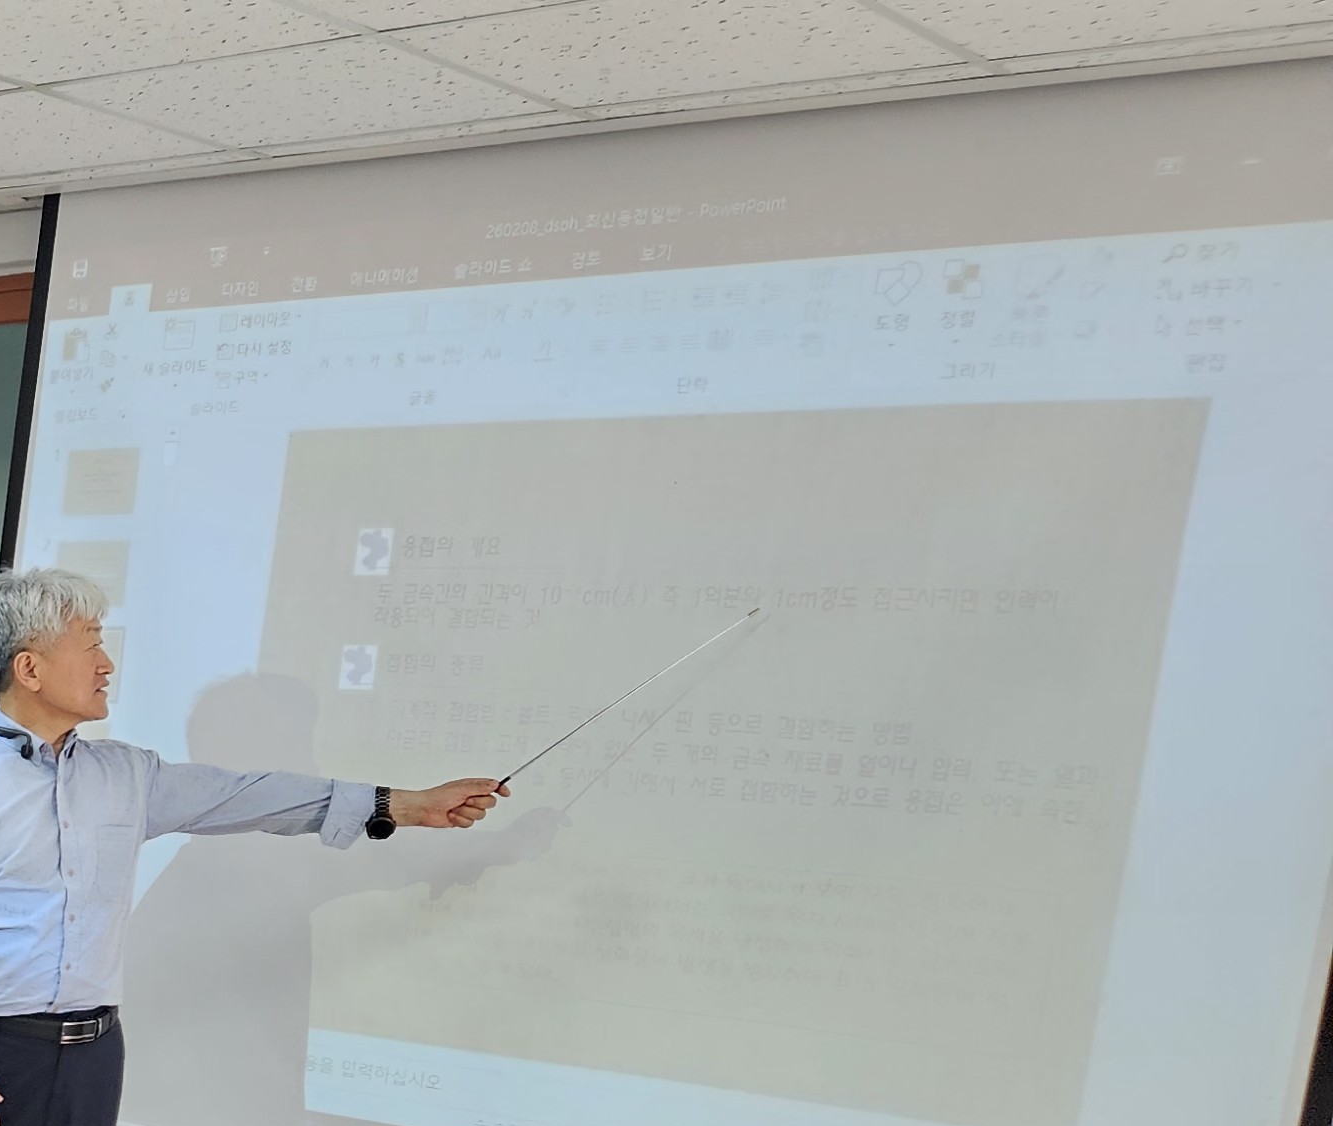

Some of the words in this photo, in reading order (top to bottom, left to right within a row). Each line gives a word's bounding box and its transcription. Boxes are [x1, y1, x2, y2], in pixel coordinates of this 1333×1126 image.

[699, 196, 788, 217] PowerPoint
[221, 281, 259, 297] 디자인
[453, 257, 512, 280] 슬라이드
[640, 244, 673, 262] 보기
[240, 314, 291, 330] 레이아웃
[874, 313, 910, 331] 도형
[1186, 315, 1227, 337] 선택
[236, 344, 263, 358] 다시
[267, 340, 292, 357] 설정
[159, 359, 208, 377] 슬라이드
[939, 361, 996, 380] 그리기
[676, 376, 710, 393] 단락
[401, 535, 453, 559] 용접의
[707, 712, 763, 737] 등으로
[832, 784, 890, 810] 것으로
[341, 1059, 442, 1091] 입력하십시오
